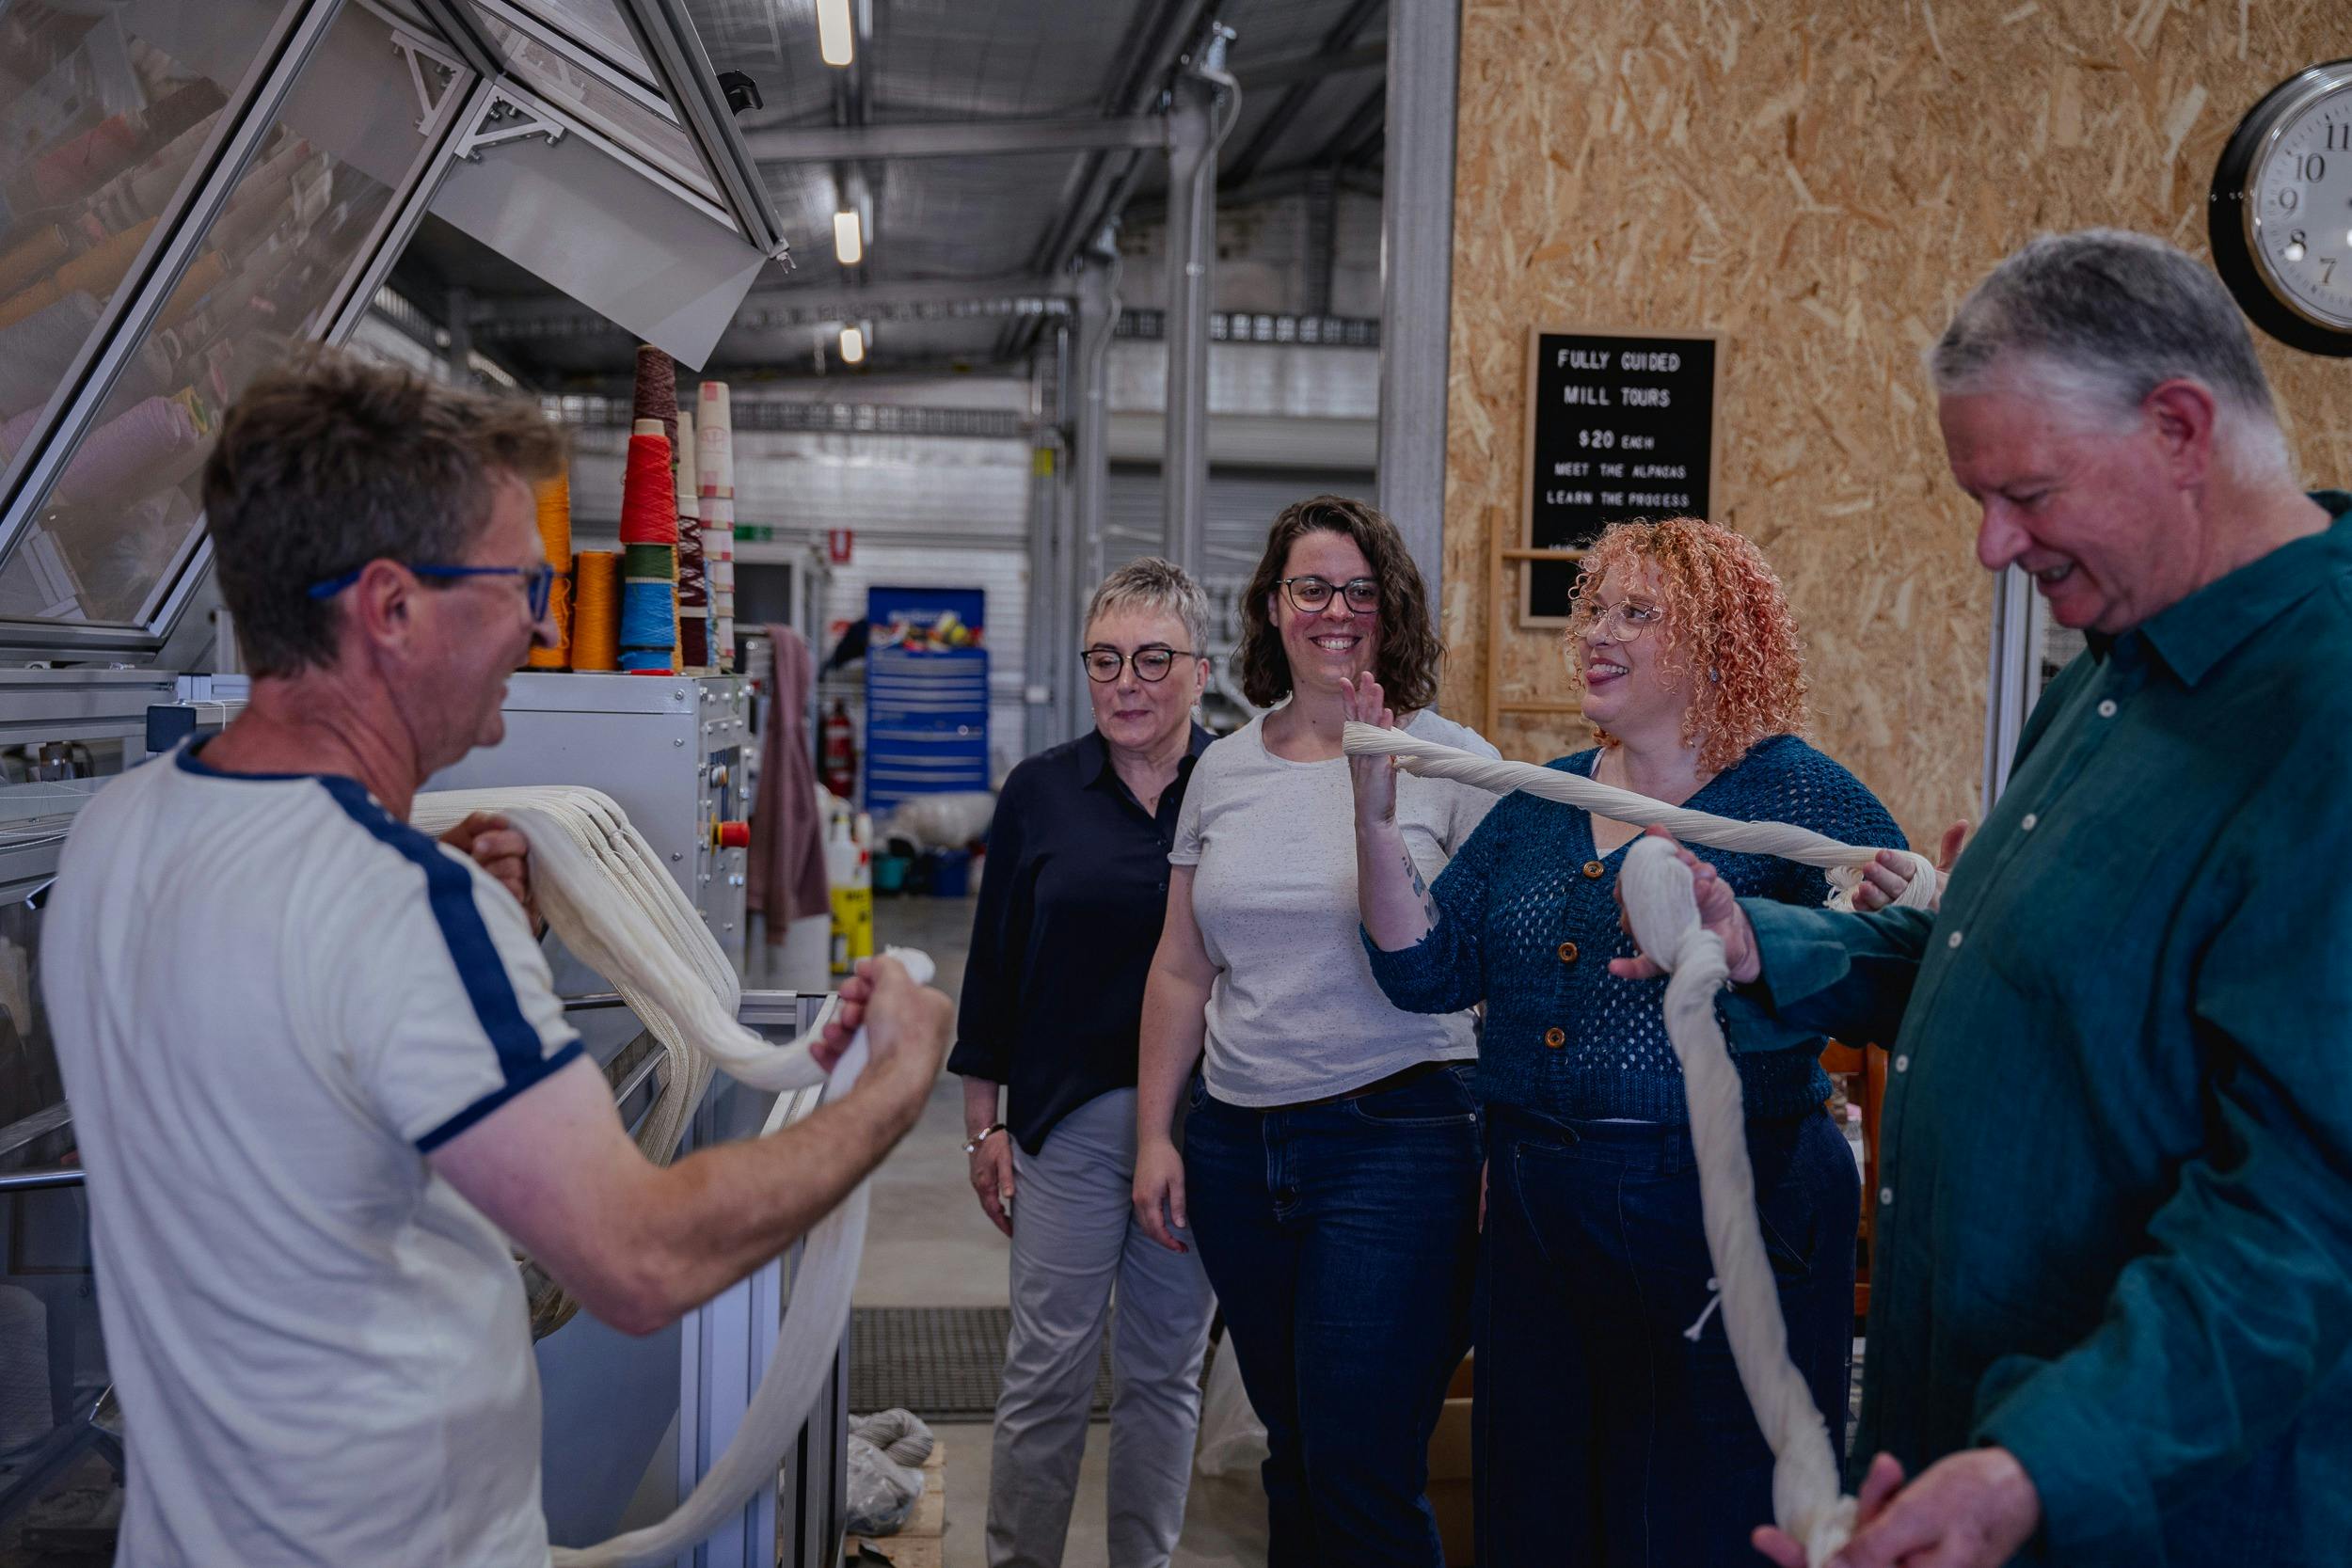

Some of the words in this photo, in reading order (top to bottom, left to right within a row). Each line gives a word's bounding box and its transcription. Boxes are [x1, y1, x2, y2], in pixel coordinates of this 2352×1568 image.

[2326, 122, 2350, 151] 11
[2295, 152, 2325, 183] 10
[2279, 187, 2297, 219] 9
[2319, 257, 2337, 285] 7
[1557, 348, 1611, 370] FULLY
[1620, 351, 1681, 372] GUIDED
[1564, 385, 1611, 406] MILL
[1621, 387, 1671, 407] TOURS
[1579, 429, 1615, 449] $20
[1621, 435, 1655, 450] EACH
[1554, 462, 1589, 477] MEET
[1600, 463, 1625, 478] THE
[1631, 464, 1687, 479] ALPACAS
[1546, 489, 1594, 505] LEARN
[1600, 491, 1624, 506] THE
[1628, 492, 1691, 508] PROCESS
